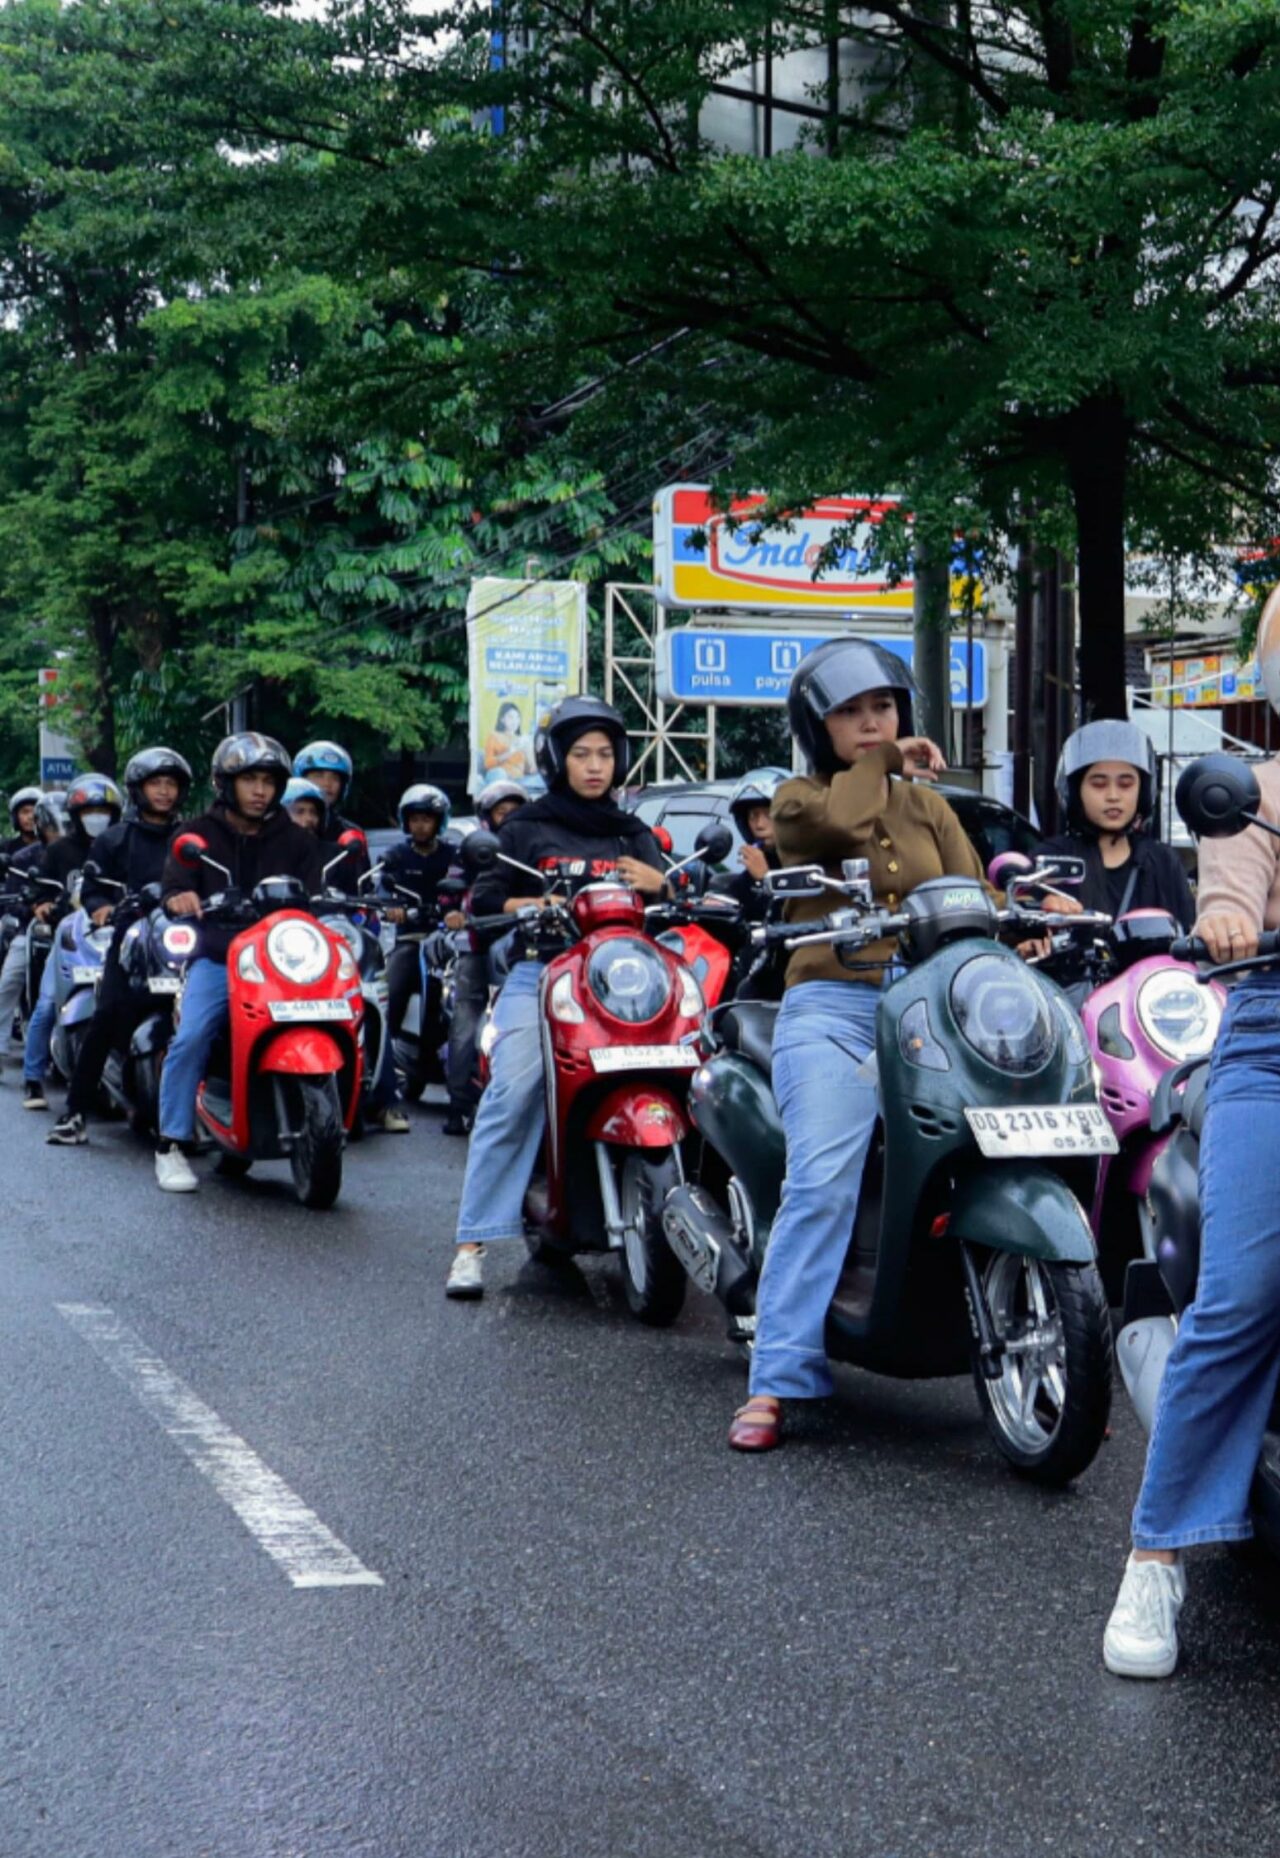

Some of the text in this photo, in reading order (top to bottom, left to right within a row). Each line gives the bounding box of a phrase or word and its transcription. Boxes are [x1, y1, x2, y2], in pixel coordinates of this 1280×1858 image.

[691, 673, 731, 689] pulsa
[46, 763, 72, 774] ATM
[972, 1109, 1103, 1132] DD 2316 XBU
